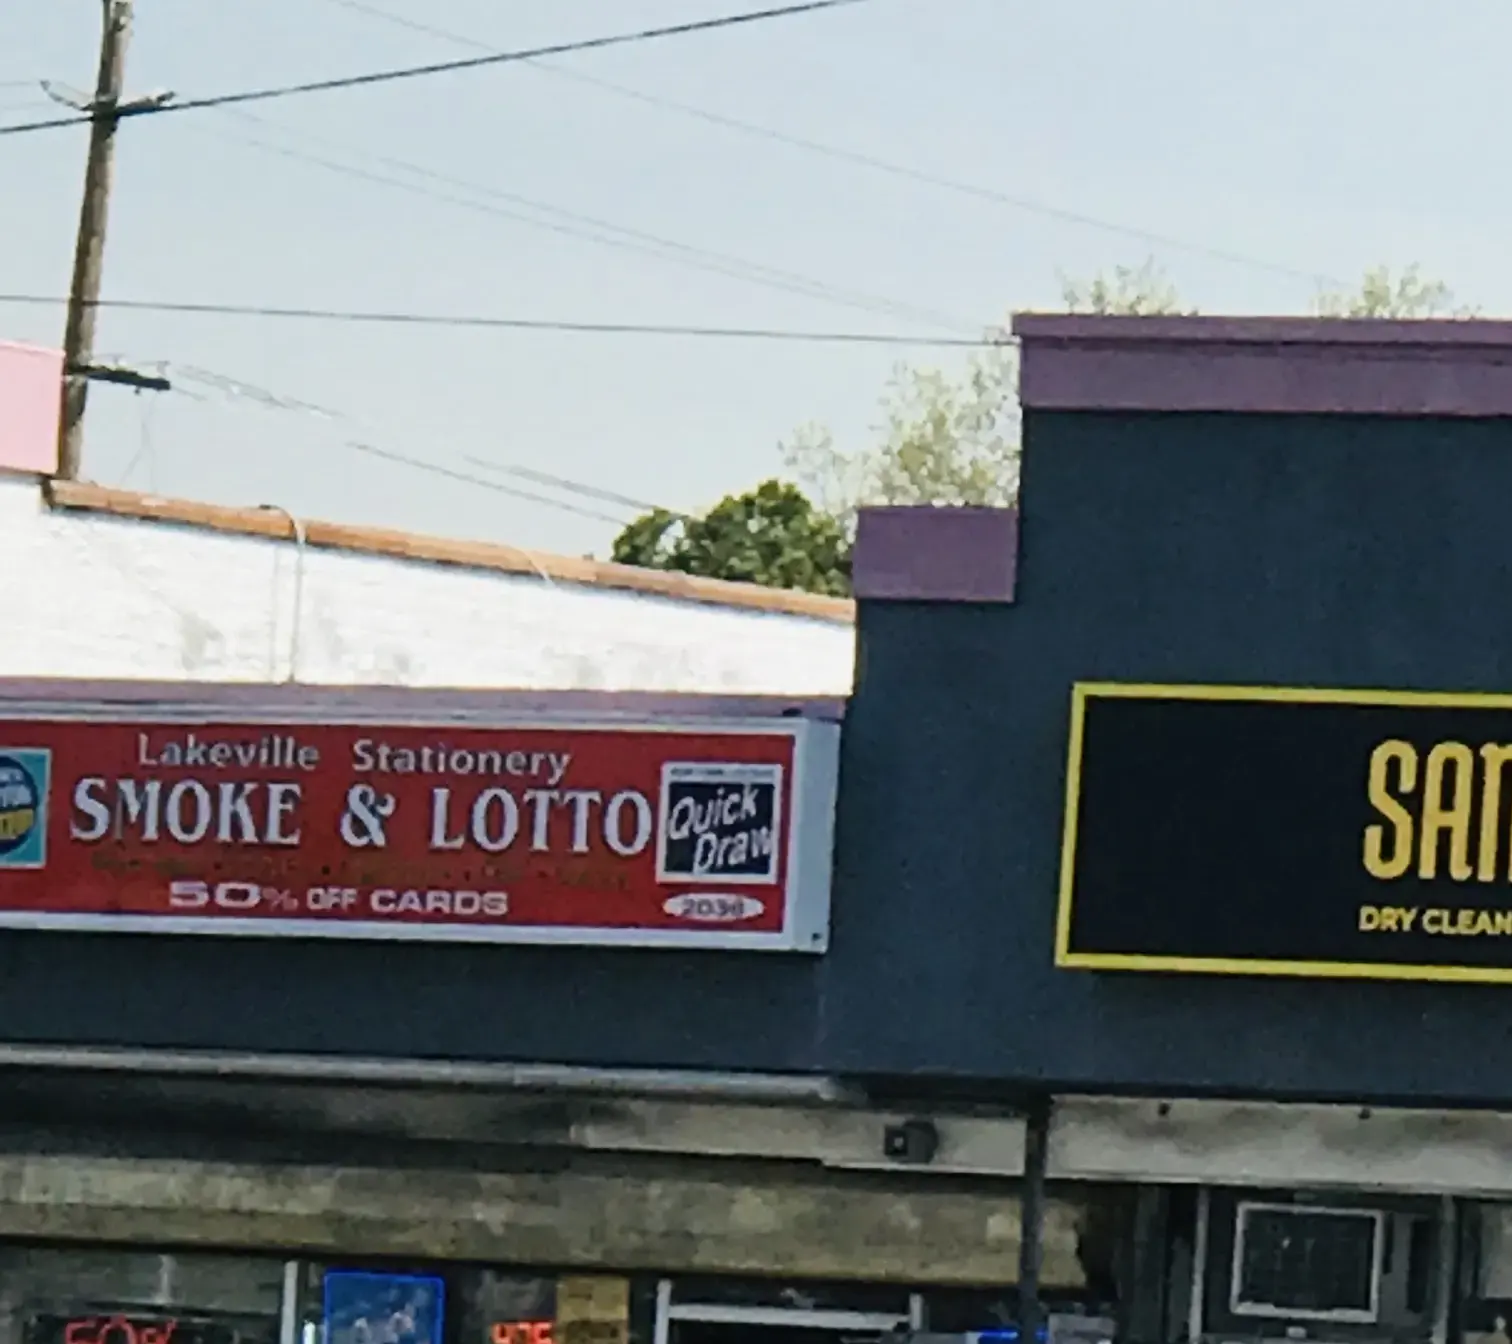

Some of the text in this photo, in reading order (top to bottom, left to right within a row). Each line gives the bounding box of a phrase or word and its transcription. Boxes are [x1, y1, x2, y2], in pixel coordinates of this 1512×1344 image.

[138, 732, 571, 785] Lakeville Stationery
[70, 777, 301, 845] SMOKE
[339, 783, 396, 848] &
[429, 786, 653, 856] LOTTO
[669, 783, 760, 840] Quick
[692, 825, 773, 875] Draw
[168, 880, 509, 916] 50% OFF CARDS
[1358, 905, 1418, 933] DRY
